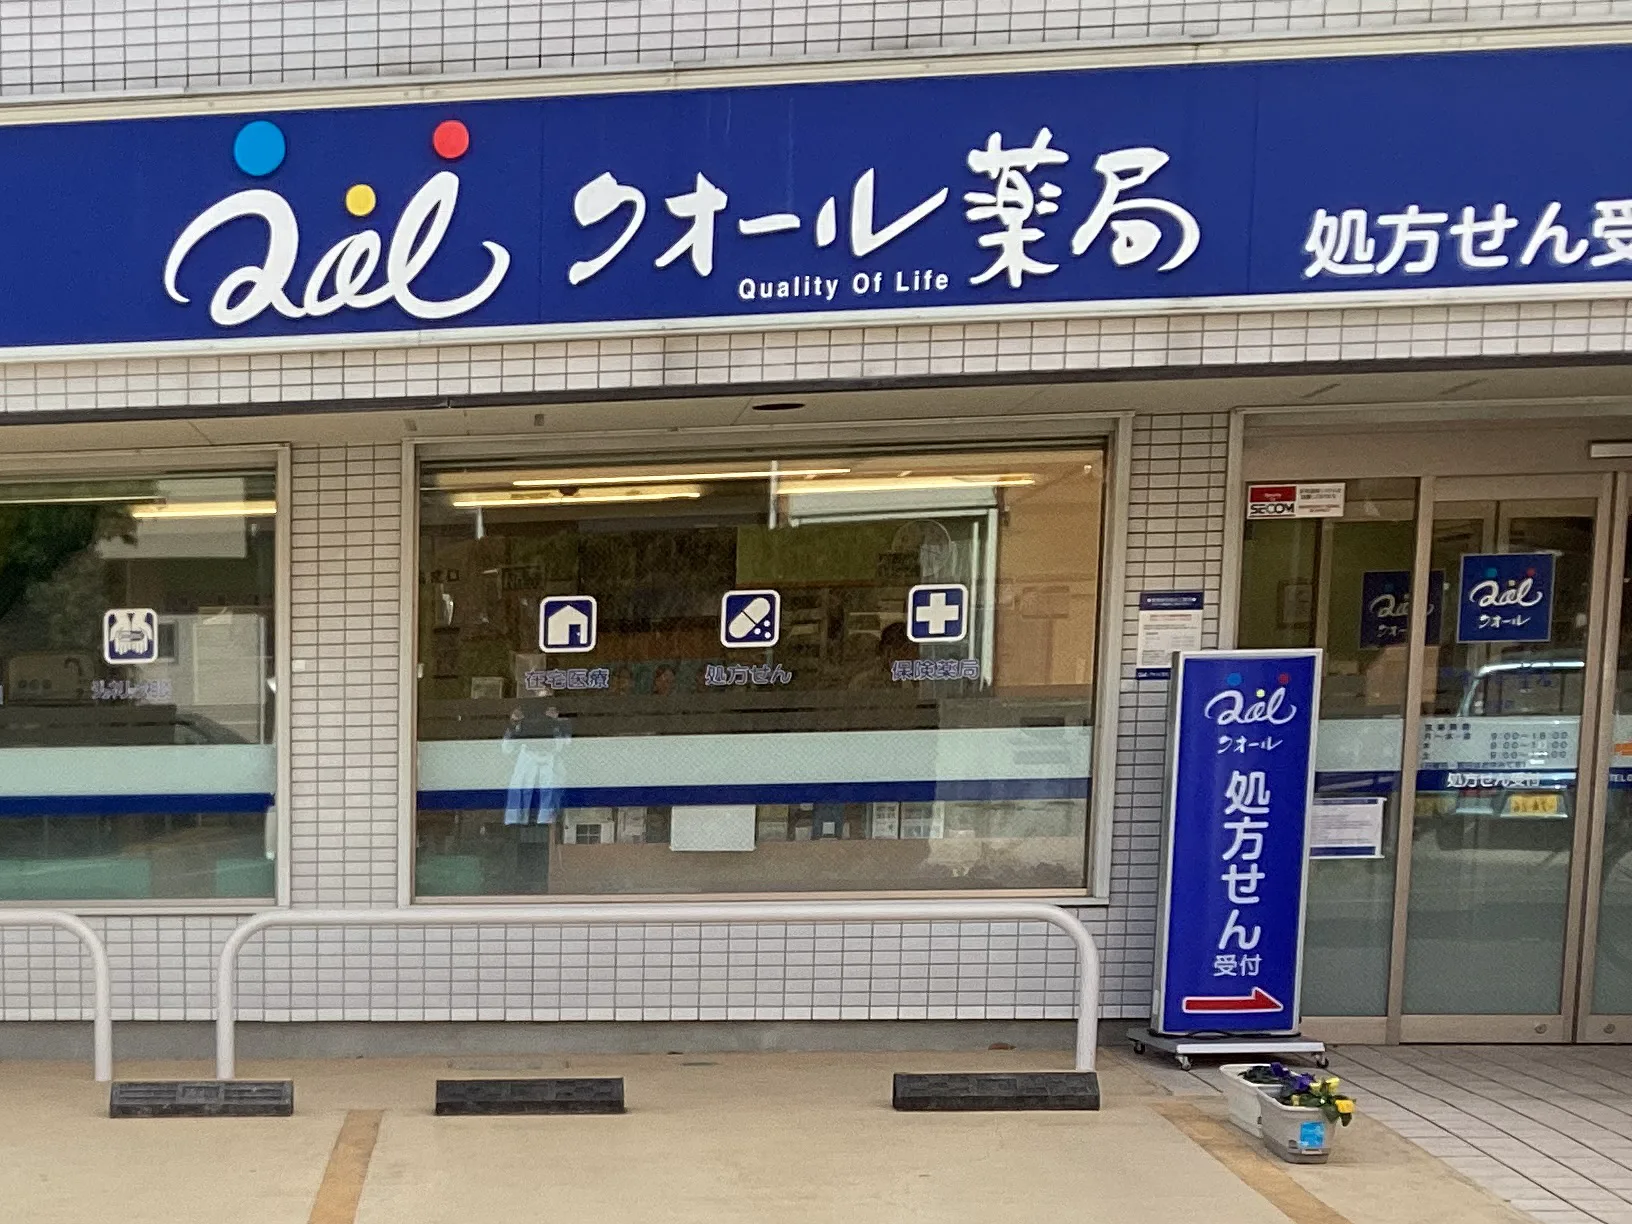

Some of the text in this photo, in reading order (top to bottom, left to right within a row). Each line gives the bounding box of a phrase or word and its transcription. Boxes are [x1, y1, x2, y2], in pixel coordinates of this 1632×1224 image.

[568, 127, 1202, 289] クオール薬局
[1304, 199, 1632, 279] 処方せん受
[739, 269, 950, 301] Quality Of Life
[1478, 613, 1531, 630] クオール
[524, 667, 609, 690] 在宅医療
[704, 663, 792, 686] 処方せん
[890, 658, 980, 682] 保険薬局
[1216, 734, 1284, 755] クオール
[1217, 770, 1271, 950] 処方せん
[1213, 953, 1263, 977] 受付
